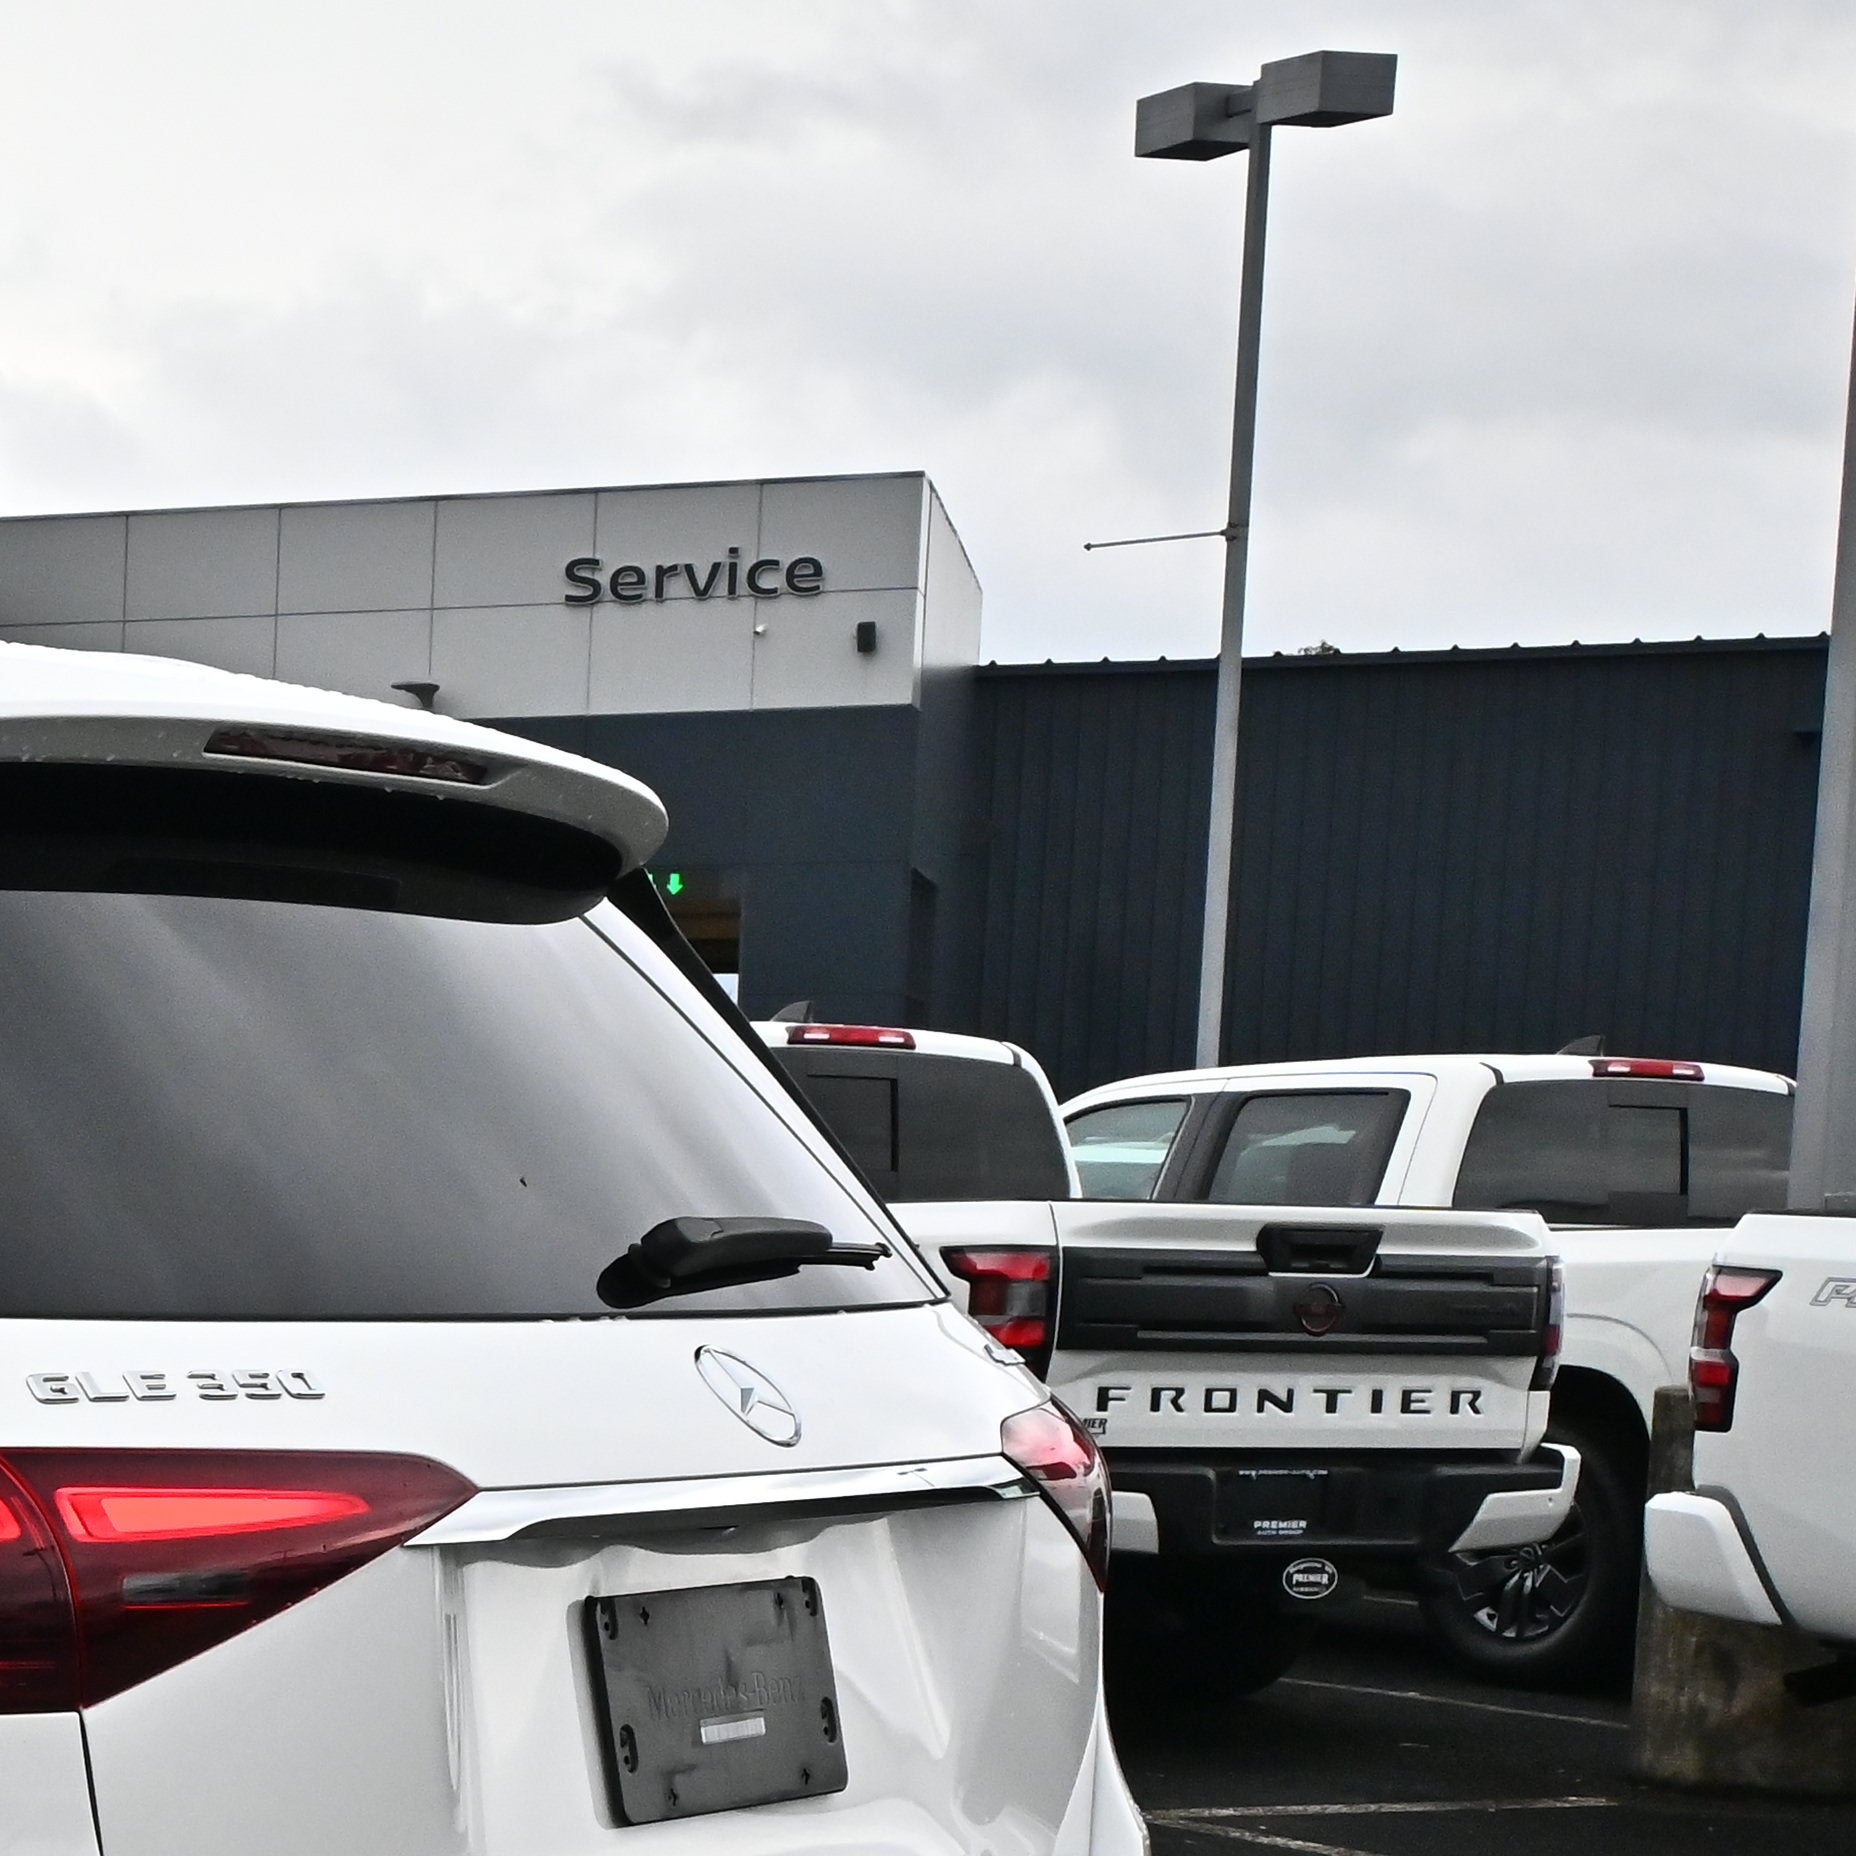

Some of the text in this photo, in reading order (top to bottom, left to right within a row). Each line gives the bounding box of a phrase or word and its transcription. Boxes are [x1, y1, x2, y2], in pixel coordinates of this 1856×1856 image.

[563, 546, 826, 606] Service
[26, 1369, 326, 1404] GLE 350
[1095, 1385, 1484, 1416] FRONTIER
[1253, 1520, 1307, 1529] PREMIER
